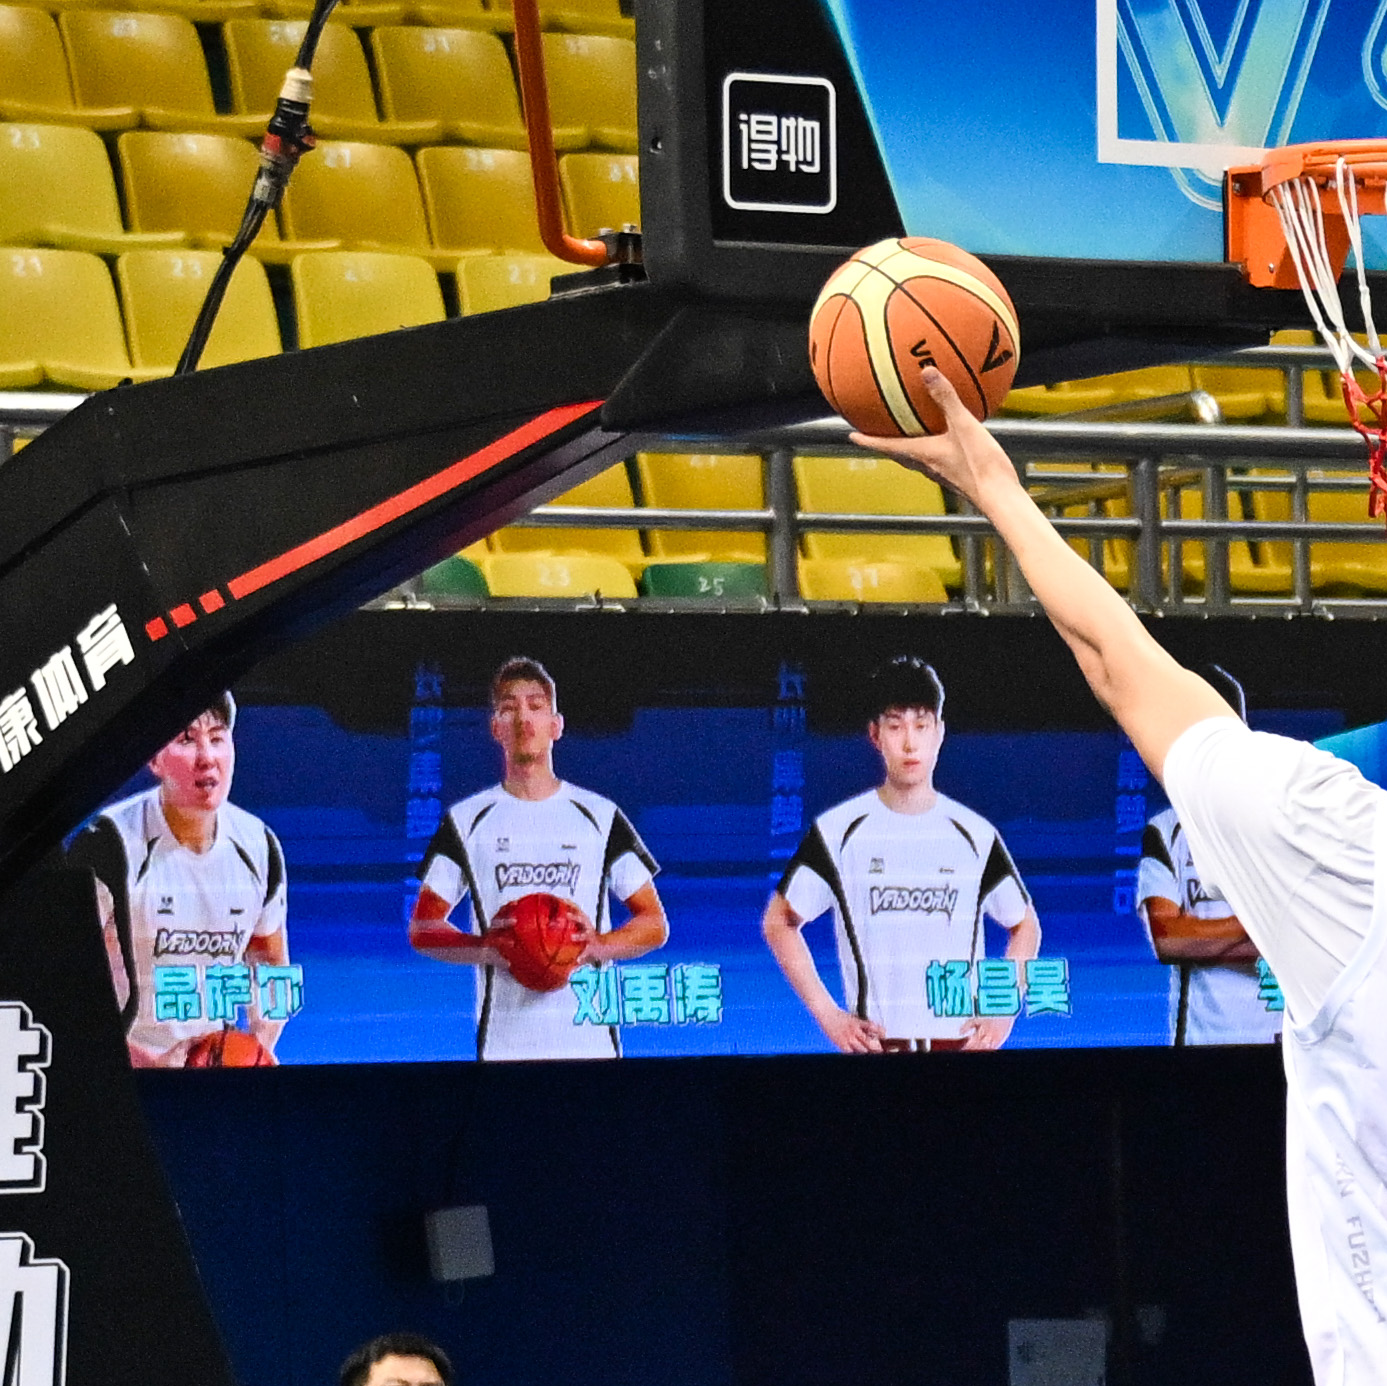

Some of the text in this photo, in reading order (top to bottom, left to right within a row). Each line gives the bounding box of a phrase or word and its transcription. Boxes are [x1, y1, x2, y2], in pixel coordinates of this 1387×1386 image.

[738, 112, 821, 174] 得物
[699, 576, 726, 597] 25
[0, 602, 136, 774] 康体育
[154, 963, 304, 1022] 昂萨尔
[569, 963, 723, 1026] 刘禹涛
[926, 959, 1072, 1018] 杨昌昊
